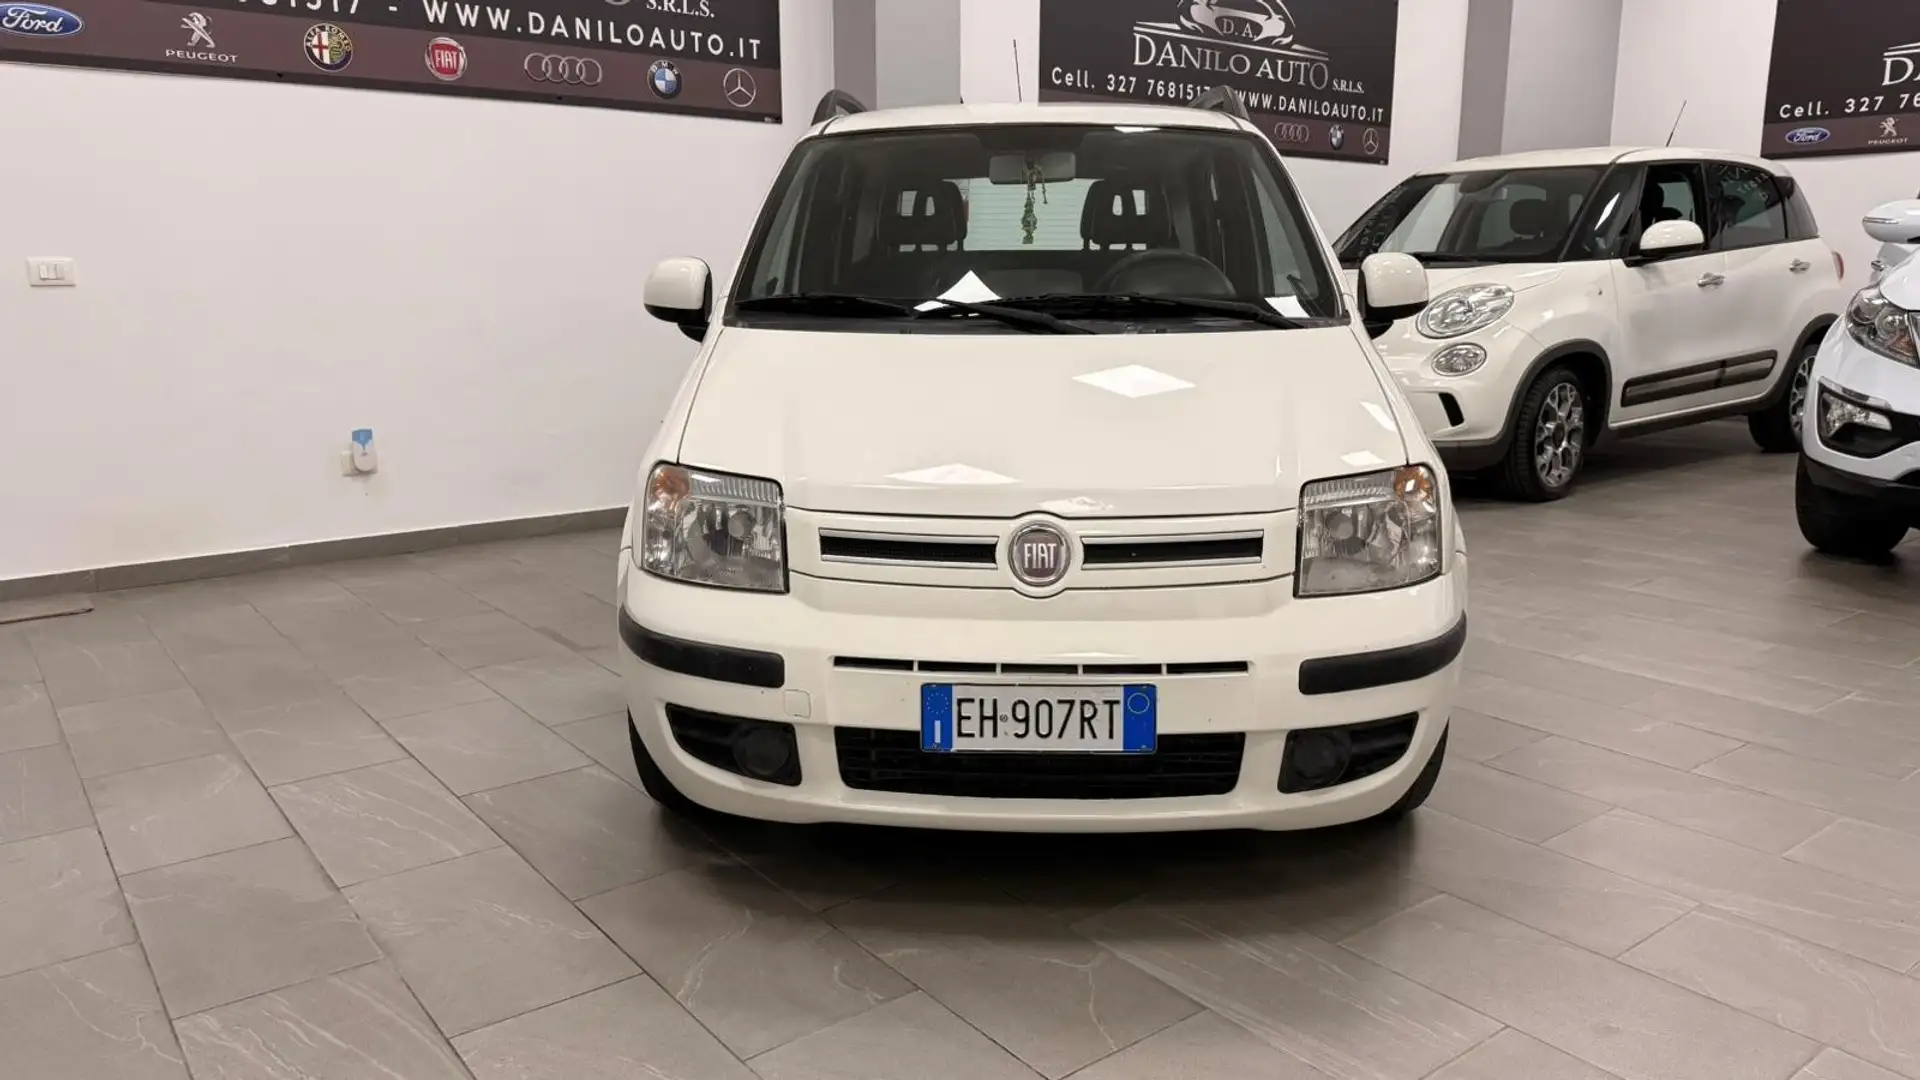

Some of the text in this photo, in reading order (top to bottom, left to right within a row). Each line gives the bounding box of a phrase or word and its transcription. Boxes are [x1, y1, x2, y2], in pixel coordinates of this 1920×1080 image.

[2, 7, 64, 33] Ford
[423, 0, 760, 59] WWW.DANILOAUTO.IT
[165, 49, 239, 63] PEUGEOT
[432, 48, 460, 69] FIAT
[1133, 33, 1250, 75] DANILO
[1255, 57, 1329, 90] AUTO
[1051, 66, 1096, 89] Cell.
[1106, 73, 1137, 94] 327
[1882, 57, 1920, 86] D
[1779, 100, 1830, 119] Cell.
[1844, 96, 1884, 114] 327
[1023, 542, 1057, 569] FIAT
